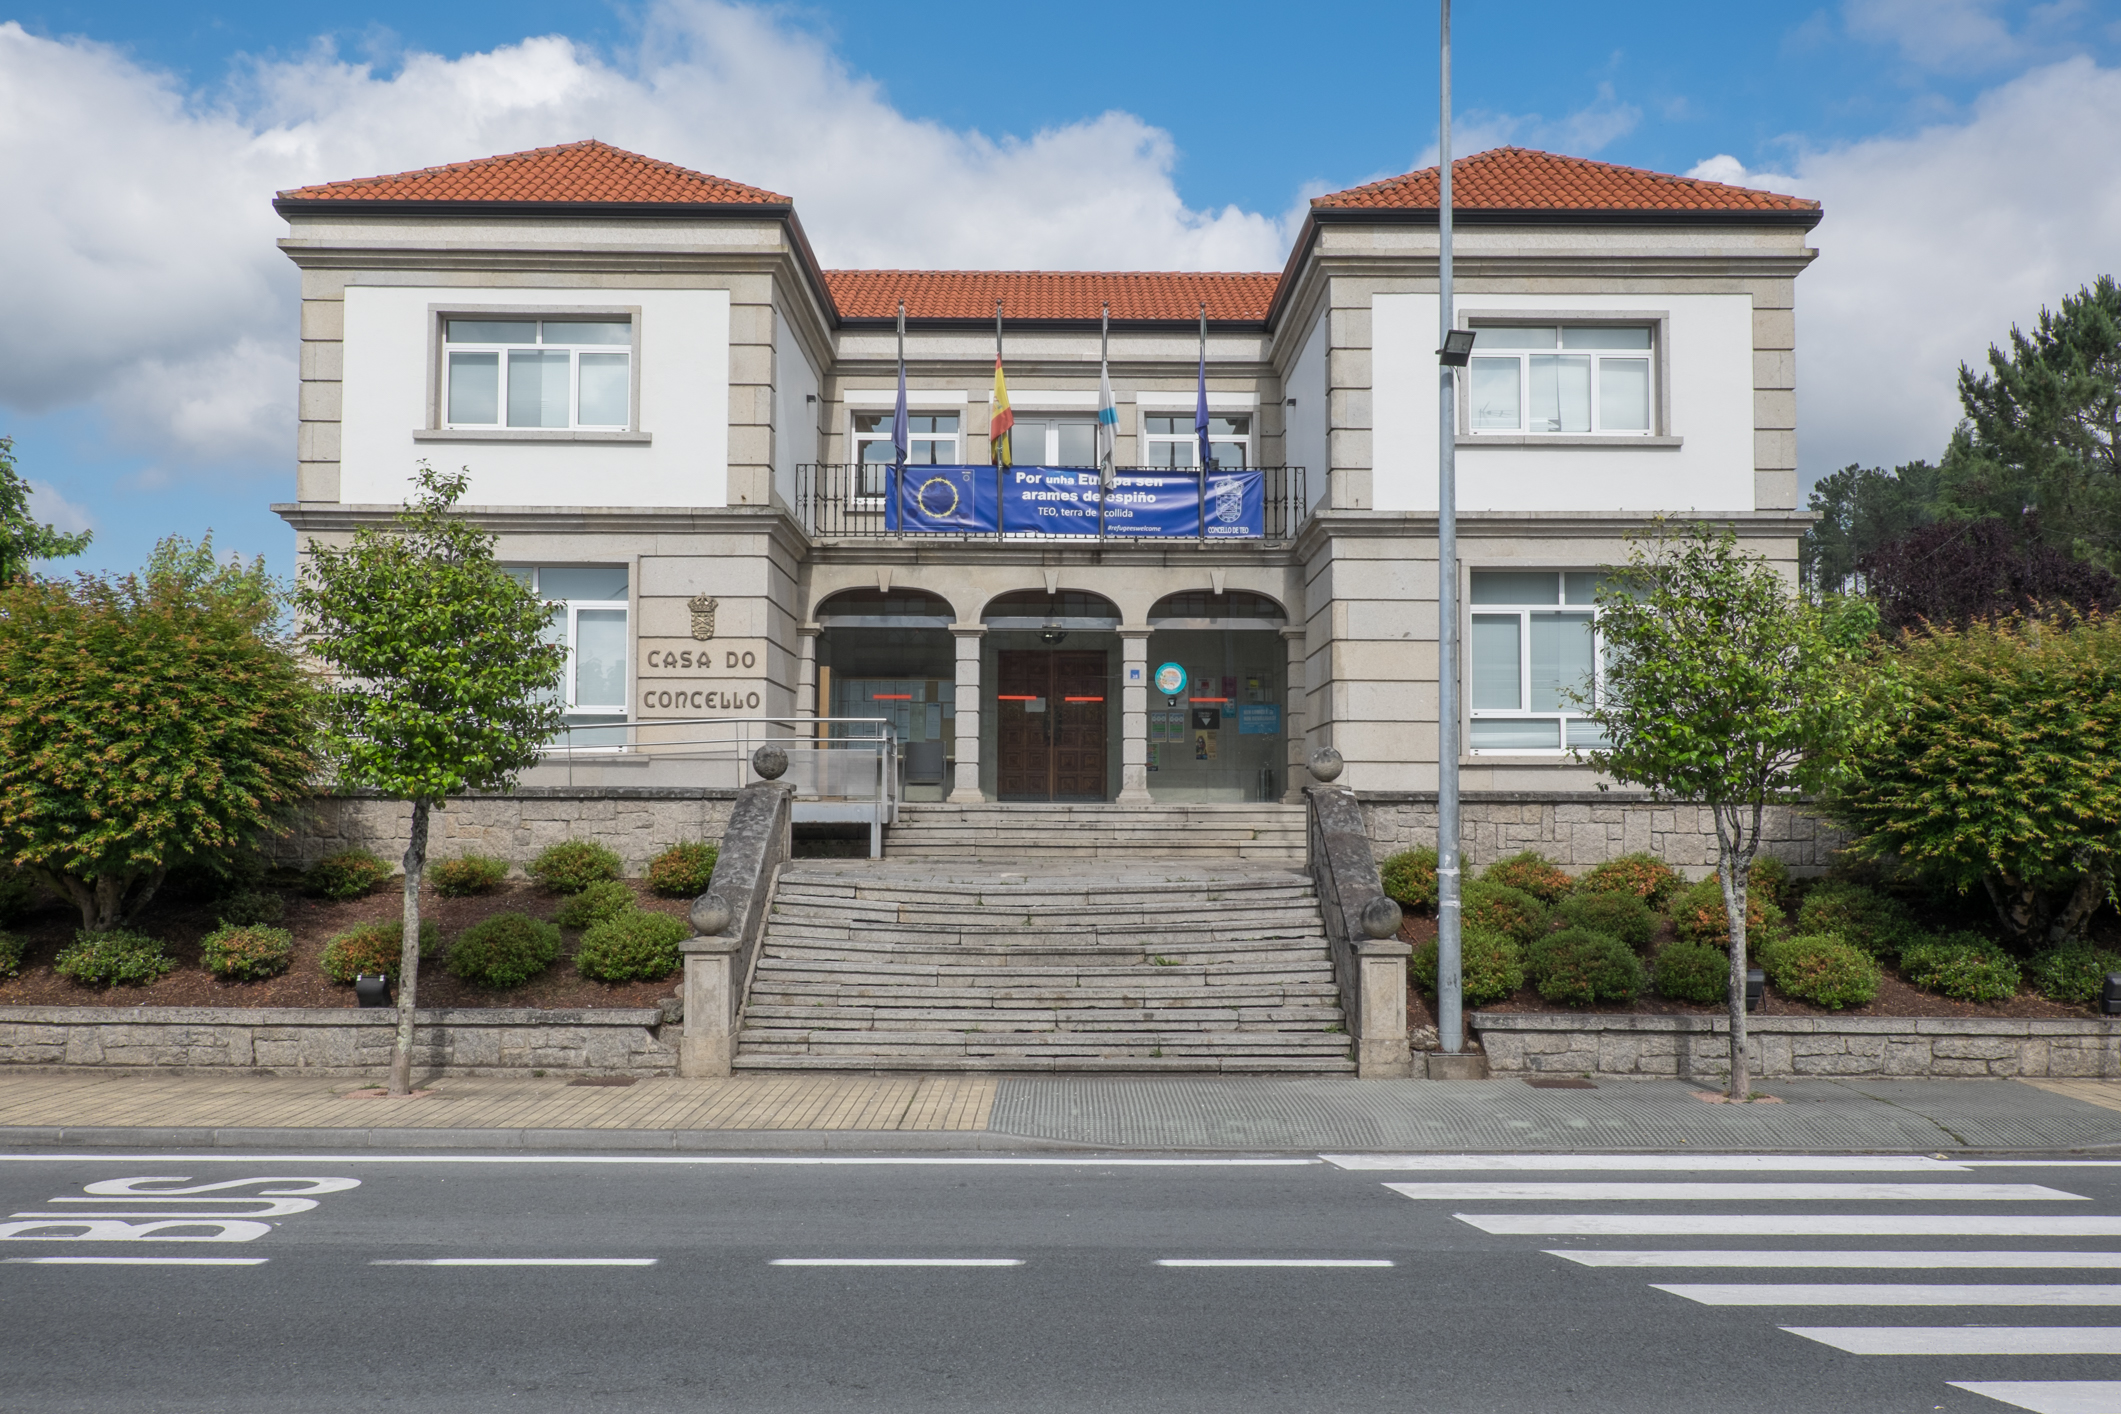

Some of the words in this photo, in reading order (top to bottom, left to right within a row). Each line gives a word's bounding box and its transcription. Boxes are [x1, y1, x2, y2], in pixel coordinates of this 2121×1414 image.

[1016, 472, 1042, 484] Por
[1046, 475, 1075, 485] unha
[1078, 474, 1131, 489] Eurpa
[1136, 477, 1163, 487] sen
[1022, 490, 1078, 501] arames
[1083, 490, 1100, 501] de
[1106, 492, 1156, 505] espiño
[1038, 507, 1059, 517] TEO,
[1061, 508, 1083, 517] terra
[1085, 508, 1097, 517] de
[1107, 525, 1161, 533] #refugeeswelcome
[1207, 526, 1232, 534] CONCELLO
[1232, 526, 1239, 534] DE
[1239, 526, 1250, 534] TEO
[647, 650, 712, 668] CASA
[726, 650, 756, 668] DO
[643, 690, 760, 709] CONCELLO
[0, 1176, 362, 1243] BUS
